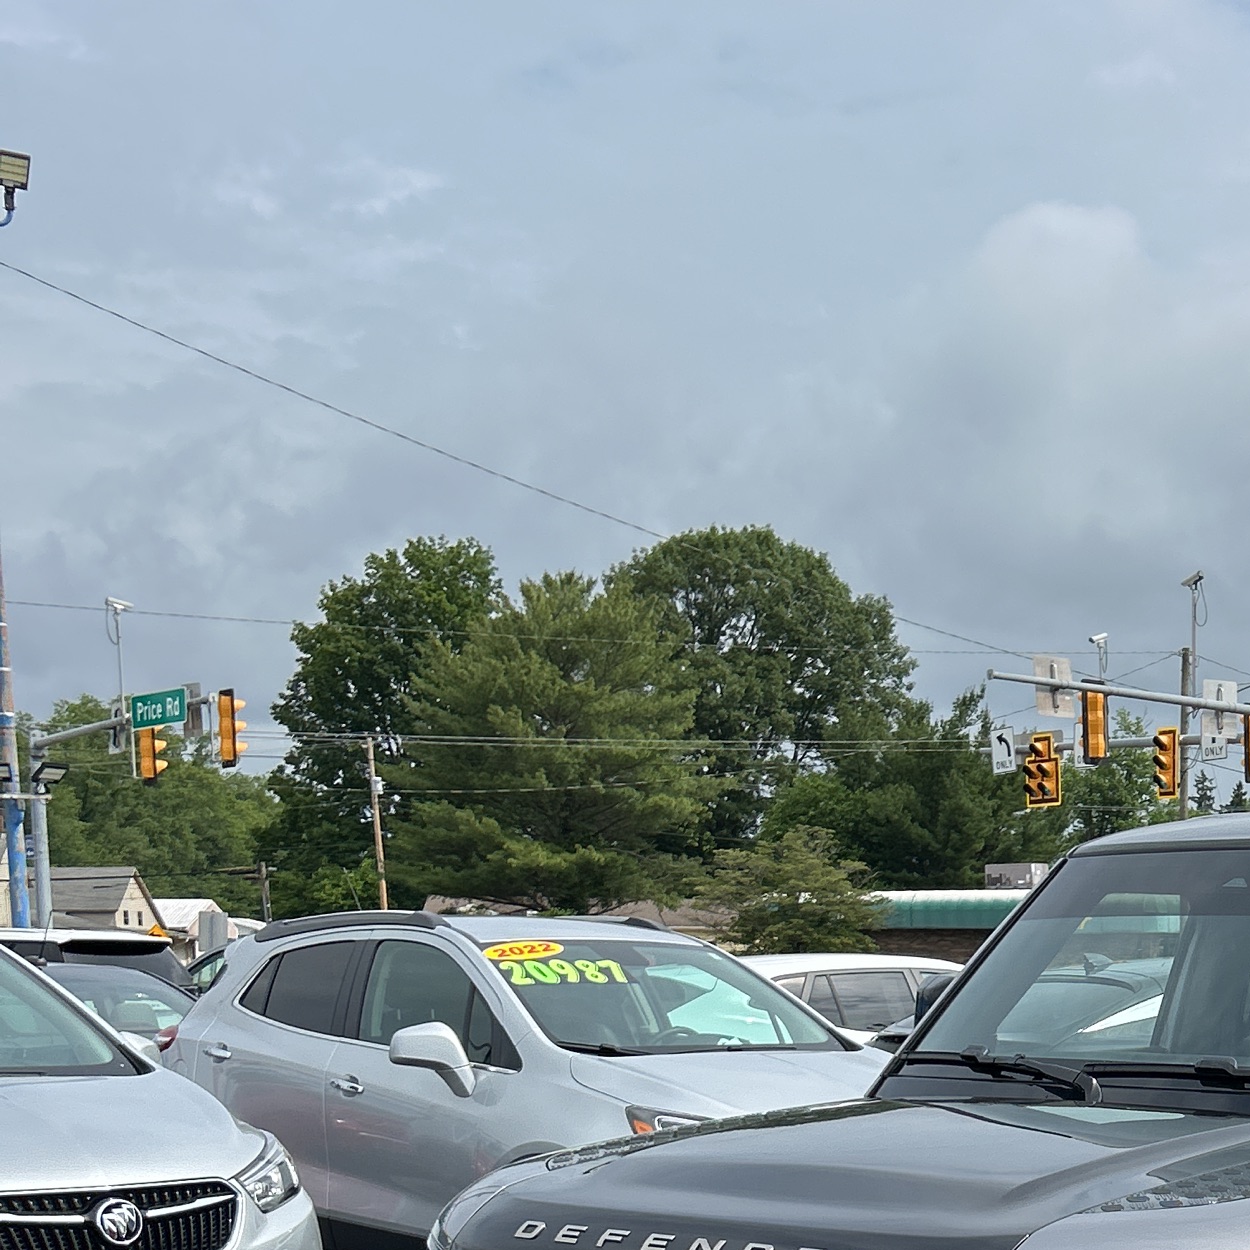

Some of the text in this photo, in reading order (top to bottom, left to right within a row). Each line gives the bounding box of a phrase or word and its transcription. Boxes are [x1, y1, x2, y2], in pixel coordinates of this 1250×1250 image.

[136, 696, 180, 722] Price Rd
[1204, 745, 1223, 757] ONLY
[996, 760, 1013, 770] ONLY
[493, 943, 556, 958] 2022
[499, 959, 629, 985] 20987
